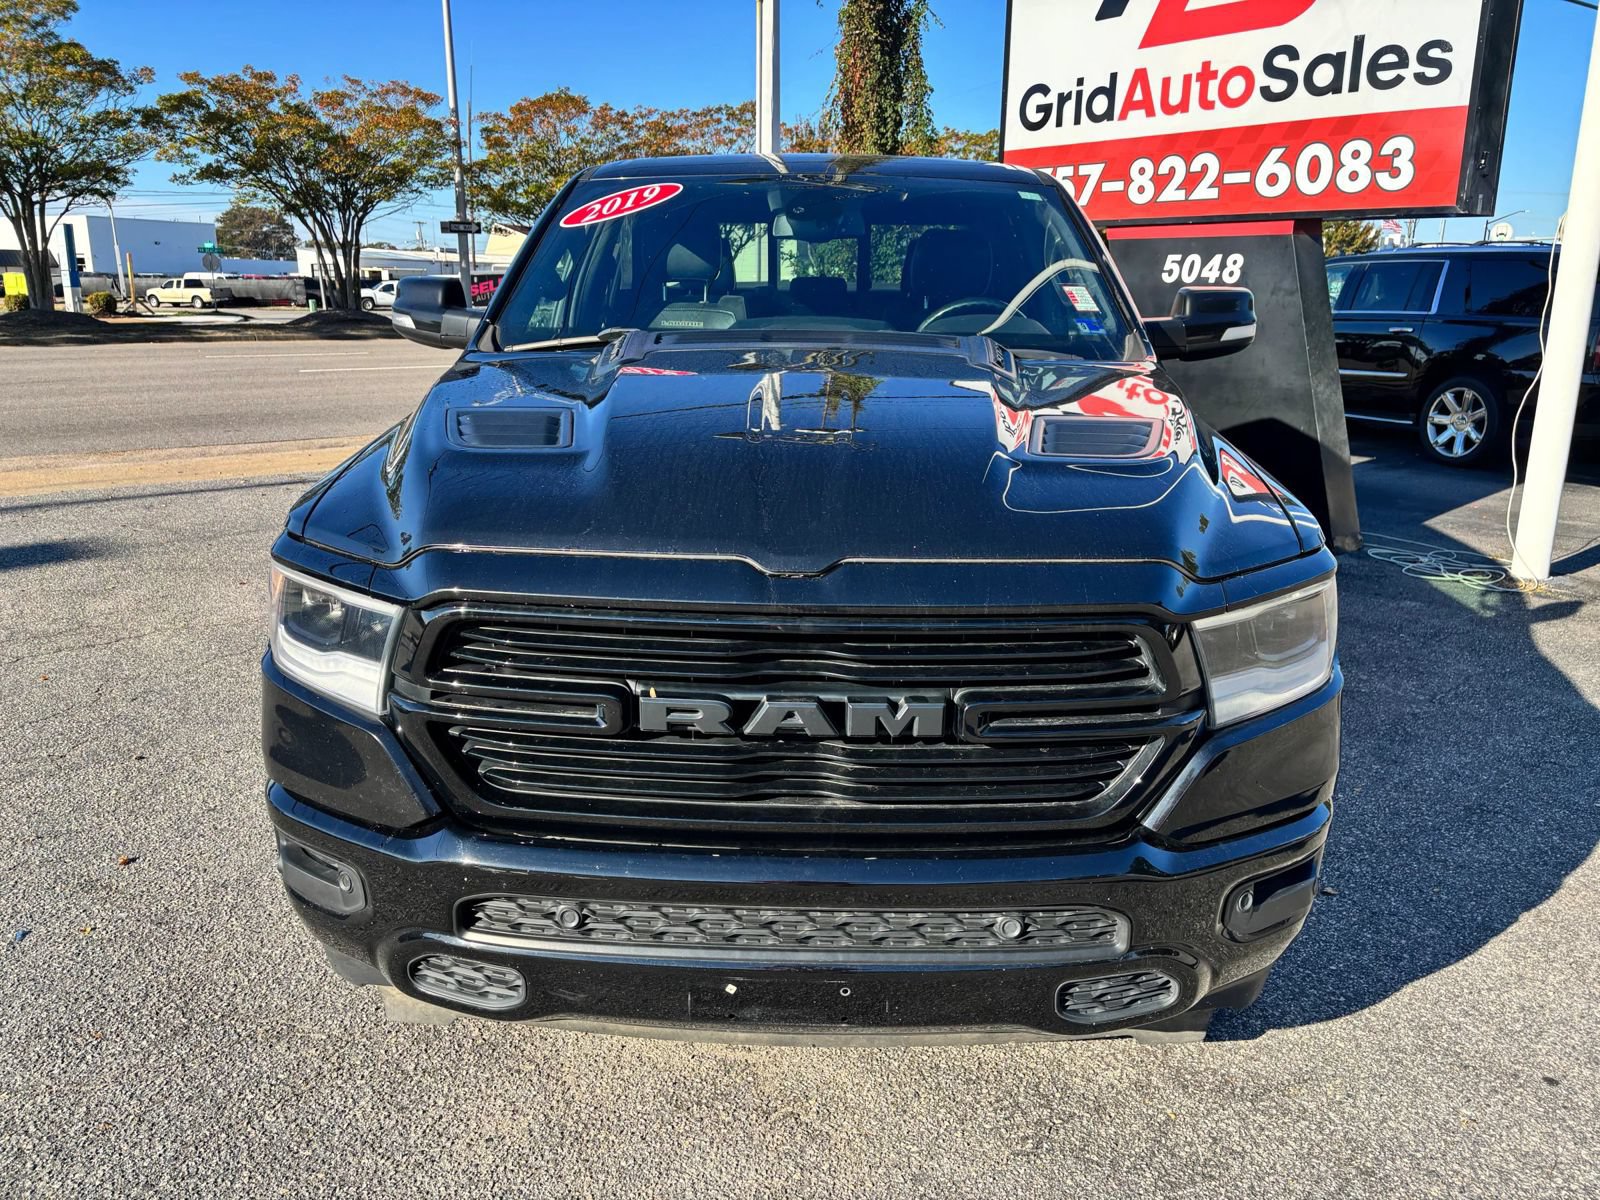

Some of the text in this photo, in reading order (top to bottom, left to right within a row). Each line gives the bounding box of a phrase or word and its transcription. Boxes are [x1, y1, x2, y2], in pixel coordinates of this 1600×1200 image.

[1033, 136, 1415, 206] 57-822-6083
[582, 186, 660, 222] 2019
[1162, 254, 1244, 284] 5048
[640, 695, 946, 737] RAM
